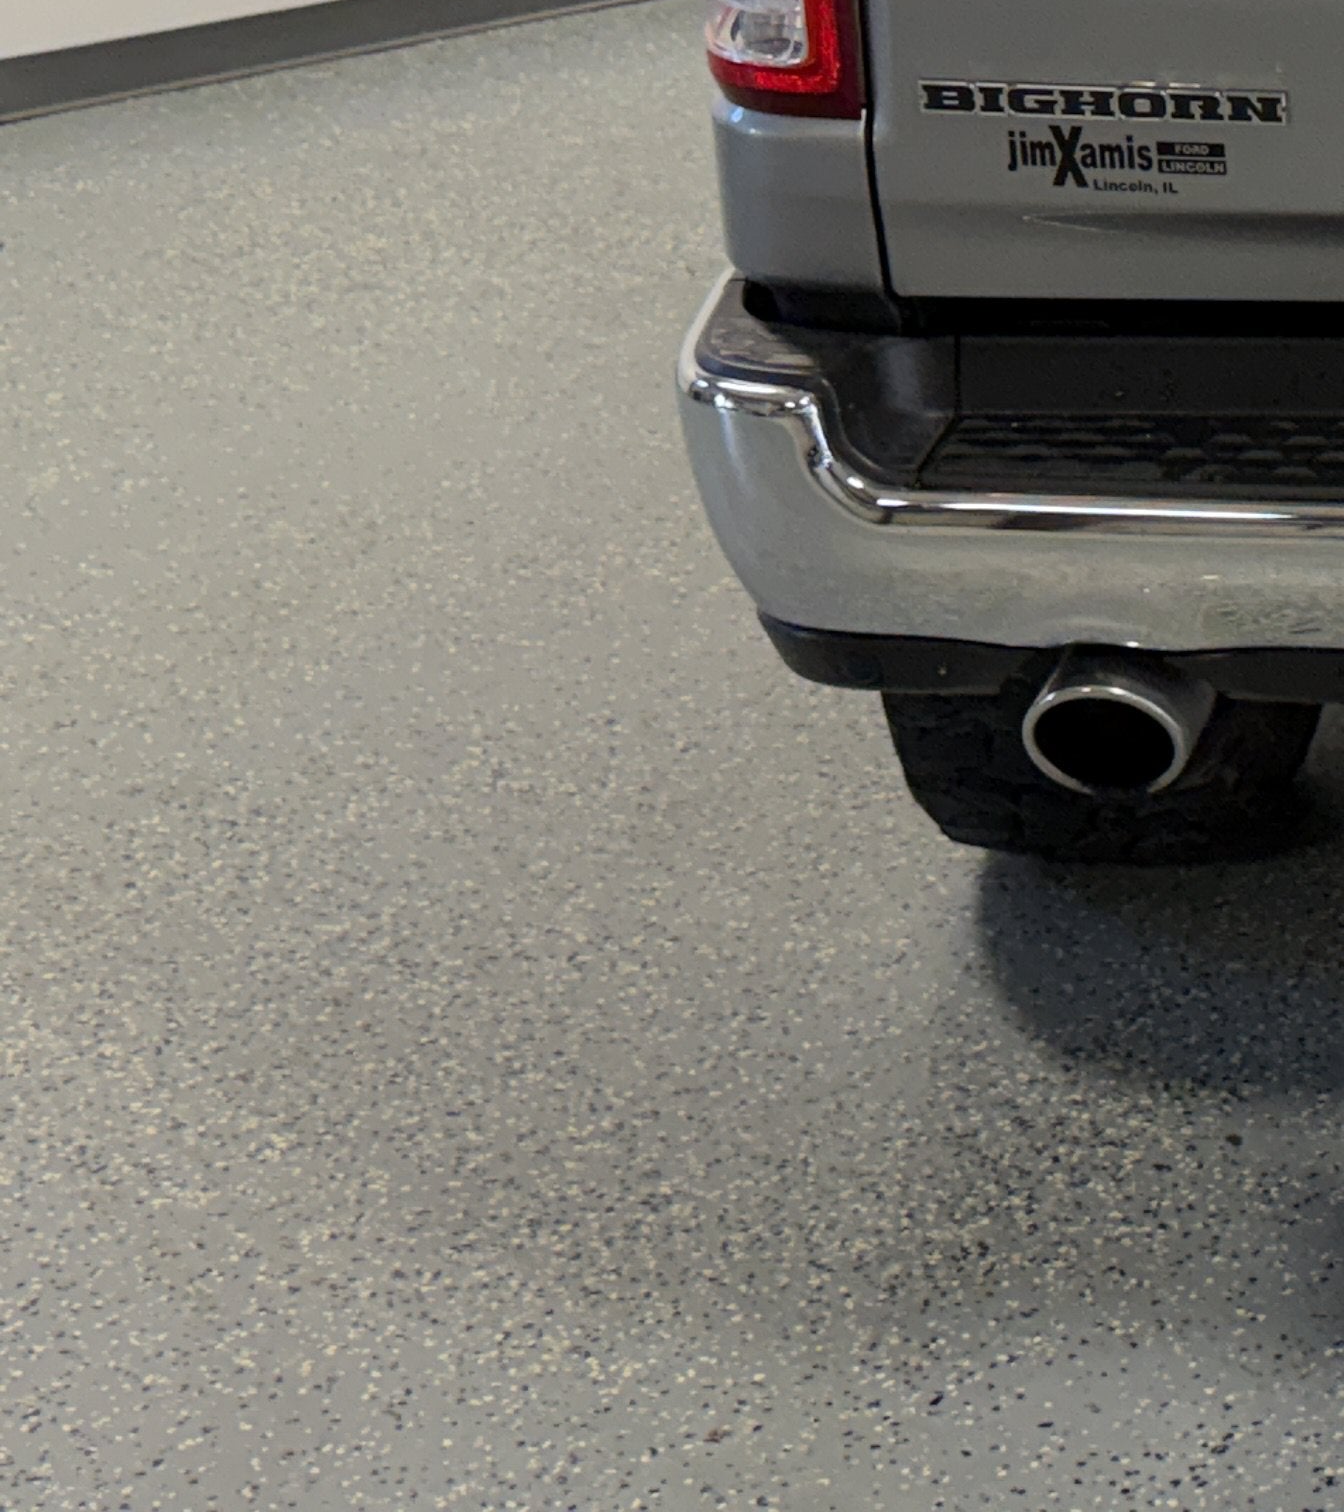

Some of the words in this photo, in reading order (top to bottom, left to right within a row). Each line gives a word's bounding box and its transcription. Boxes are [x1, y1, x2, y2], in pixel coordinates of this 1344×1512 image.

[918, 79, 1288, 125] BIGHORN
[1161, 159, 1225, 174] LINCOLN
[1093, 178, 1158, 195] Lincoln,
[1162, 181, 1179, 194] IL
